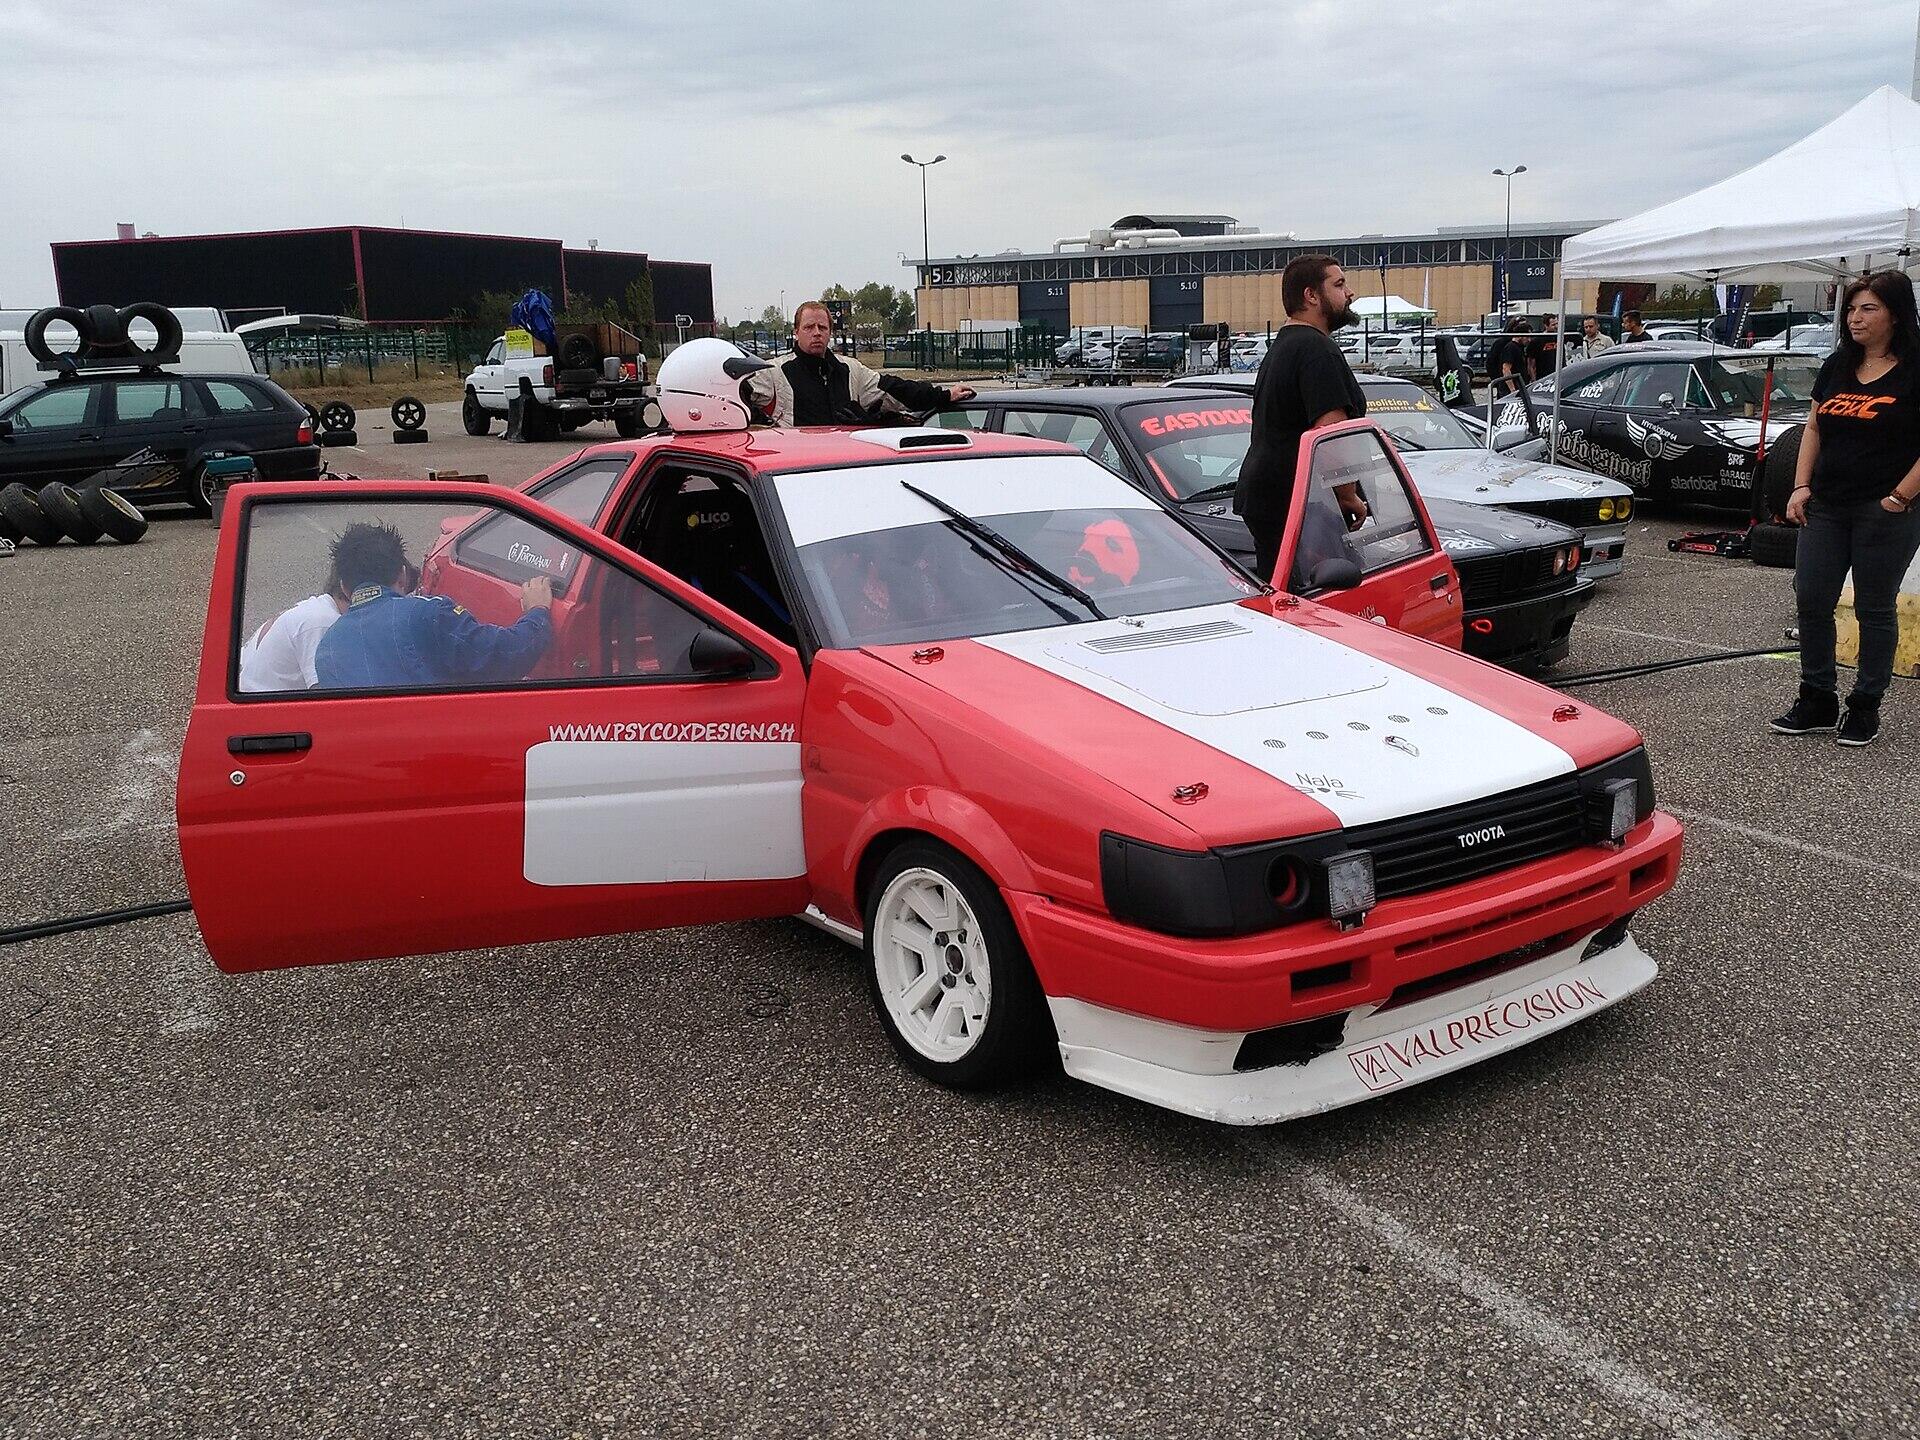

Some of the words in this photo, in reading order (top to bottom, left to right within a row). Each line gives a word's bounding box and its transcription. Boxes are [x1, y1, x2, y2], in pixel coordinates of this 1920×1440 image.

[1526, 266, 1546, 277] 5.08
[1047, 286, 1064, 296] 5.11
[1180, 280, 1198, 290] 5.10
[1738, 357, 1789, 366] FEDEAL
[1366, 398, 1410, 408] molition
[1719, 468, 1752, 481] GARAGE
[549, 722, 796, 742] WWW.PSYCOXDESIGN.CH
[1295, 772, 1344, 789] Nala
[1458, 825, 1506, 848] TOYOTA
[1383, 976, 1608, 1068] VALPRÉCISION
